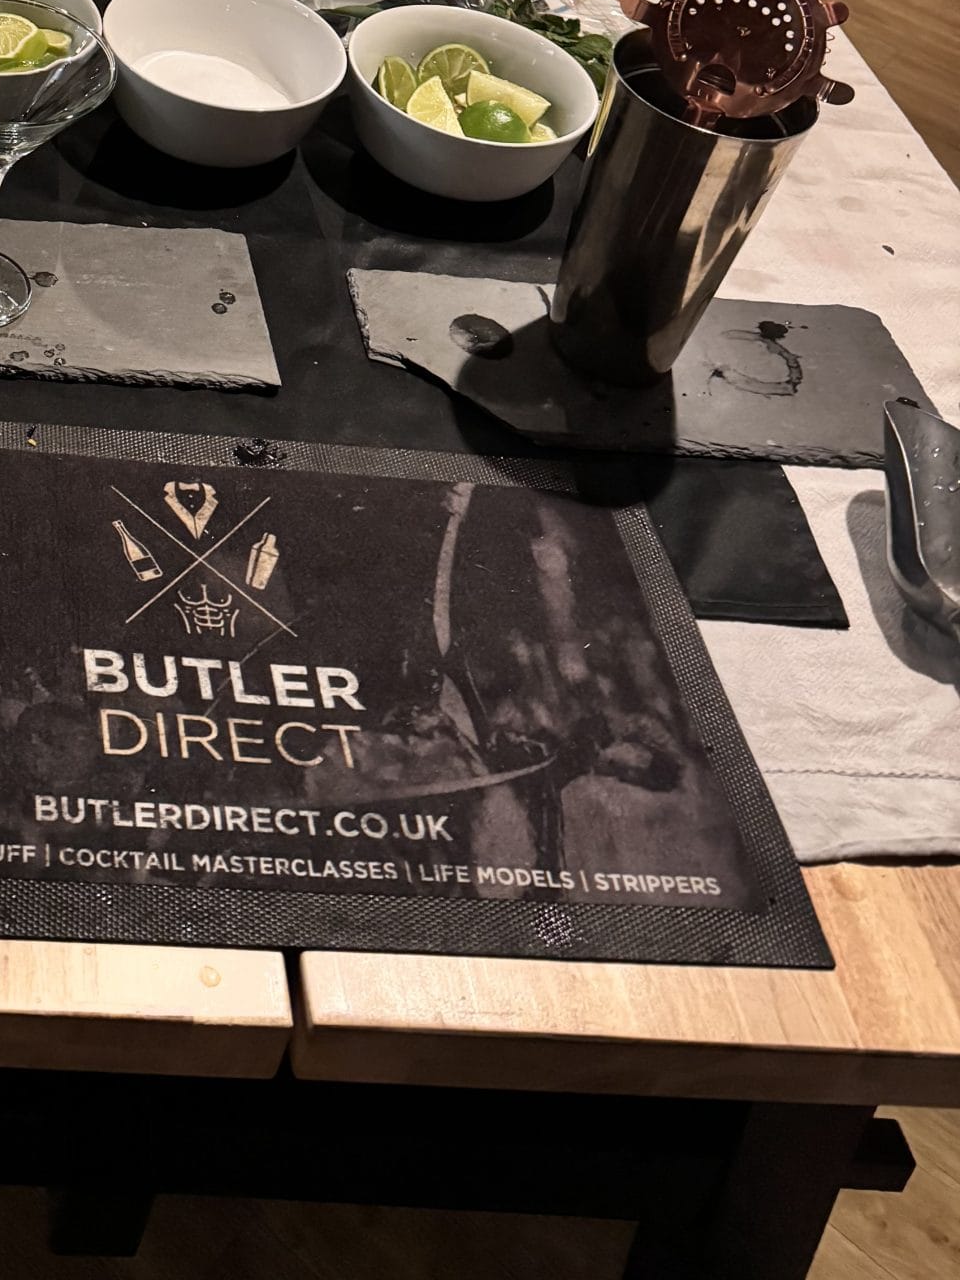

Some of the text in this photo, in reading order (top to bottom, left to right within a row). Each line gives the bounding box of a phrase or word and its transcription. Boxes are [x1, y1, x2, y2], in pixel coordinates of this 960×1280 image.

[83, 648, 367, 710] BUTLER
[99, 708, 361, 769] DIRECT
[34, 794, 453, 842] BUTLERDIRECT.CO.UK
[58, 847, 185, 871] COCKTAIL
[192, 854, 398, 880] MASTERCLASSES
[419, 863, 471, 884] LIFE
[476, 867, 575, 890] MODELS
[594, 873, 721, 895] STRIPPERS
